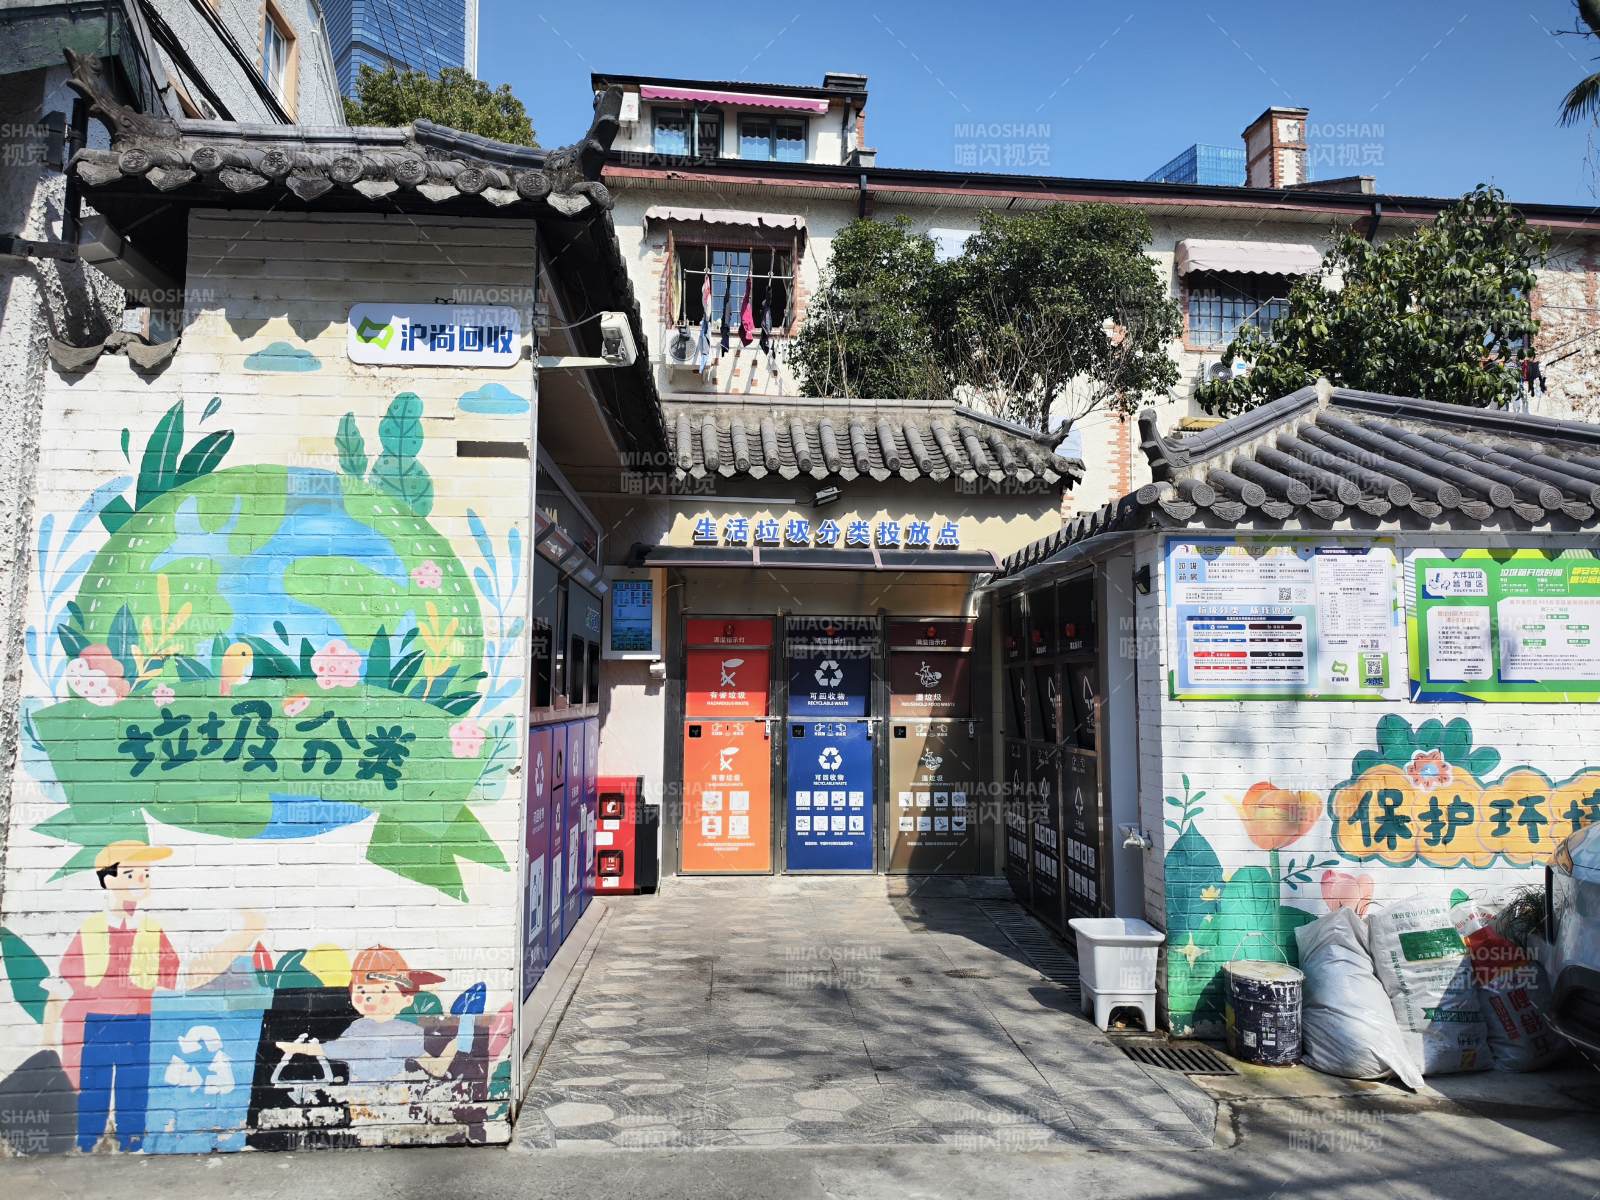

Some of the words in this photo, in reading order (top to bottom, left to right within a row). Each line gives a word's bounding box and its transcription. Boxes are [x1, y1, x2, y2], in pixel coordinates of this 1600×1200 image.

[401, 323, 513, 354] 沪尚回收
[694, 517, 961, 546] 生活垃圾分类投放点
[709, 691, 747, 700] 有害垃圾
[809, 692, 846, 701] 可回收物
[118, 700, 417, 790] 垃圾分类
[814, 774, 845, 782] 可回收物
